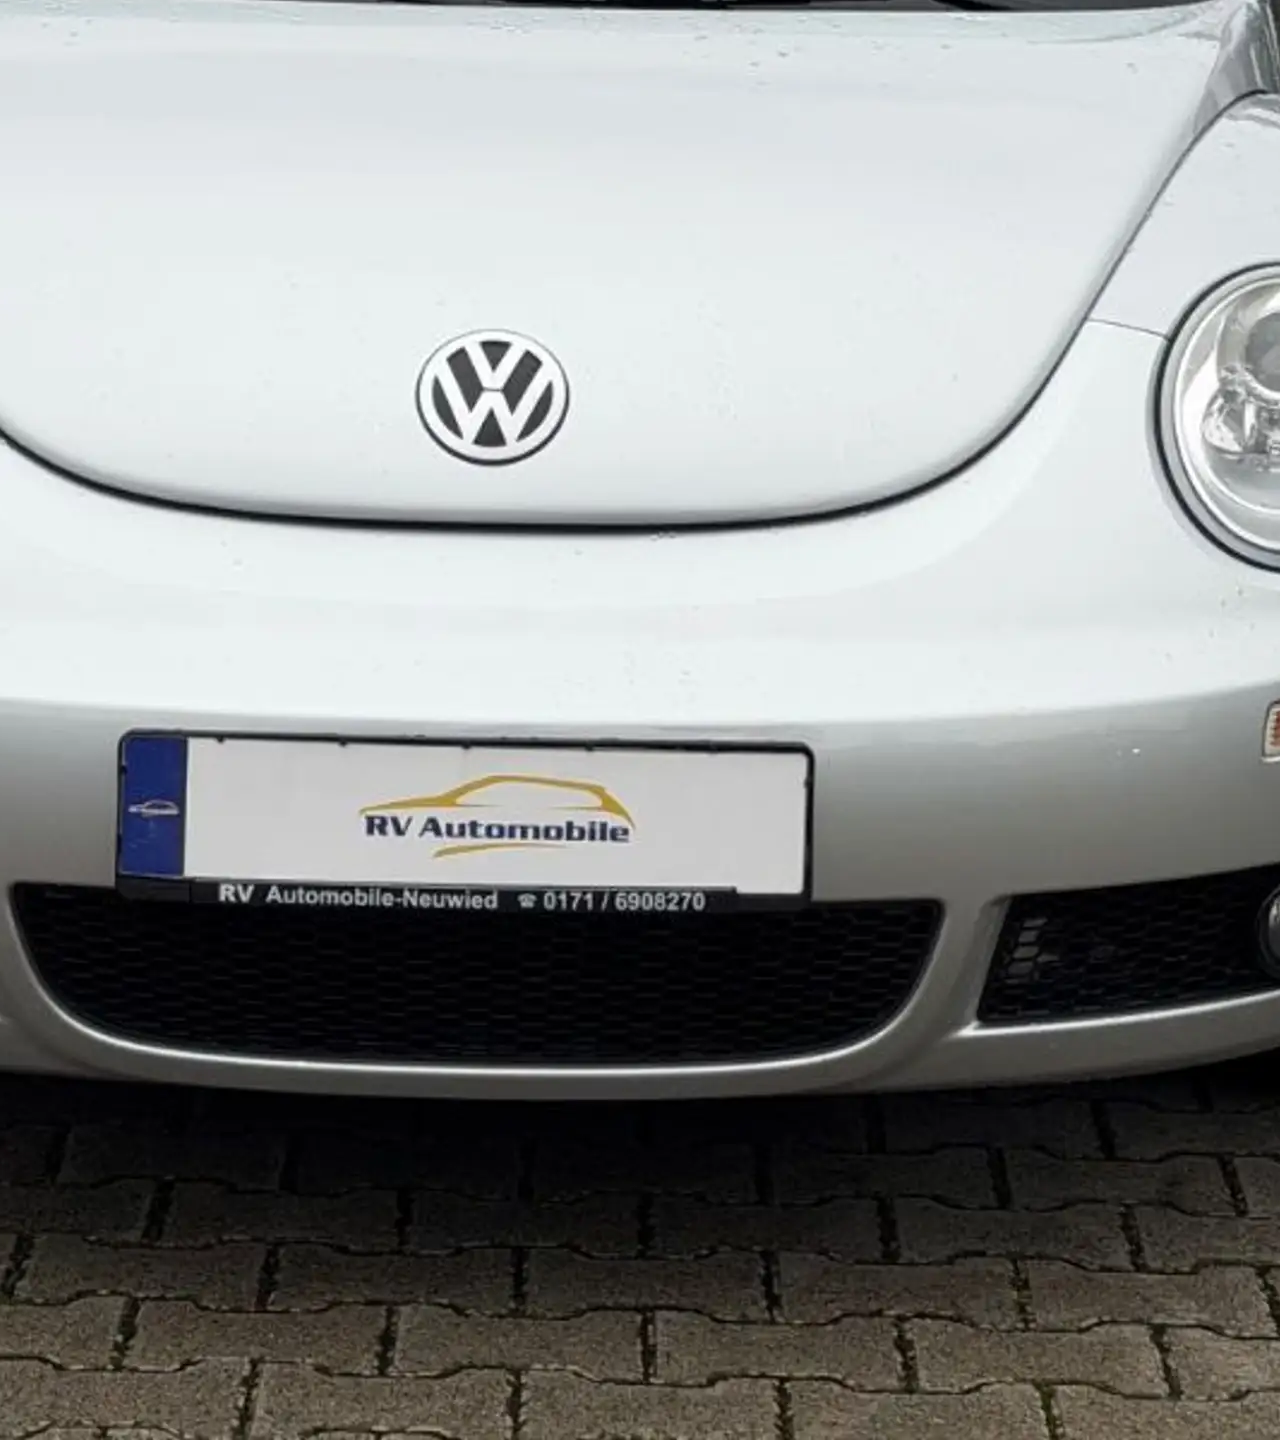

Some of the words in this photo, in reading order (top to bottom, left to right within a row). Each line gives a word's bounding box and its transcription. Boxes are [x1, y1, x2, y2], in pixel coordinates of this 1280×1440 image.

[365, 814, 413, 837] RV
[418, 815, 631, 843] Automobile
[219, 882, 255, 904] RV
[265, 883, 500, 910] Automobile-Neuwied
[542, 891, 594, 911] 0171
[614, 891, 706, 912] 6908270
